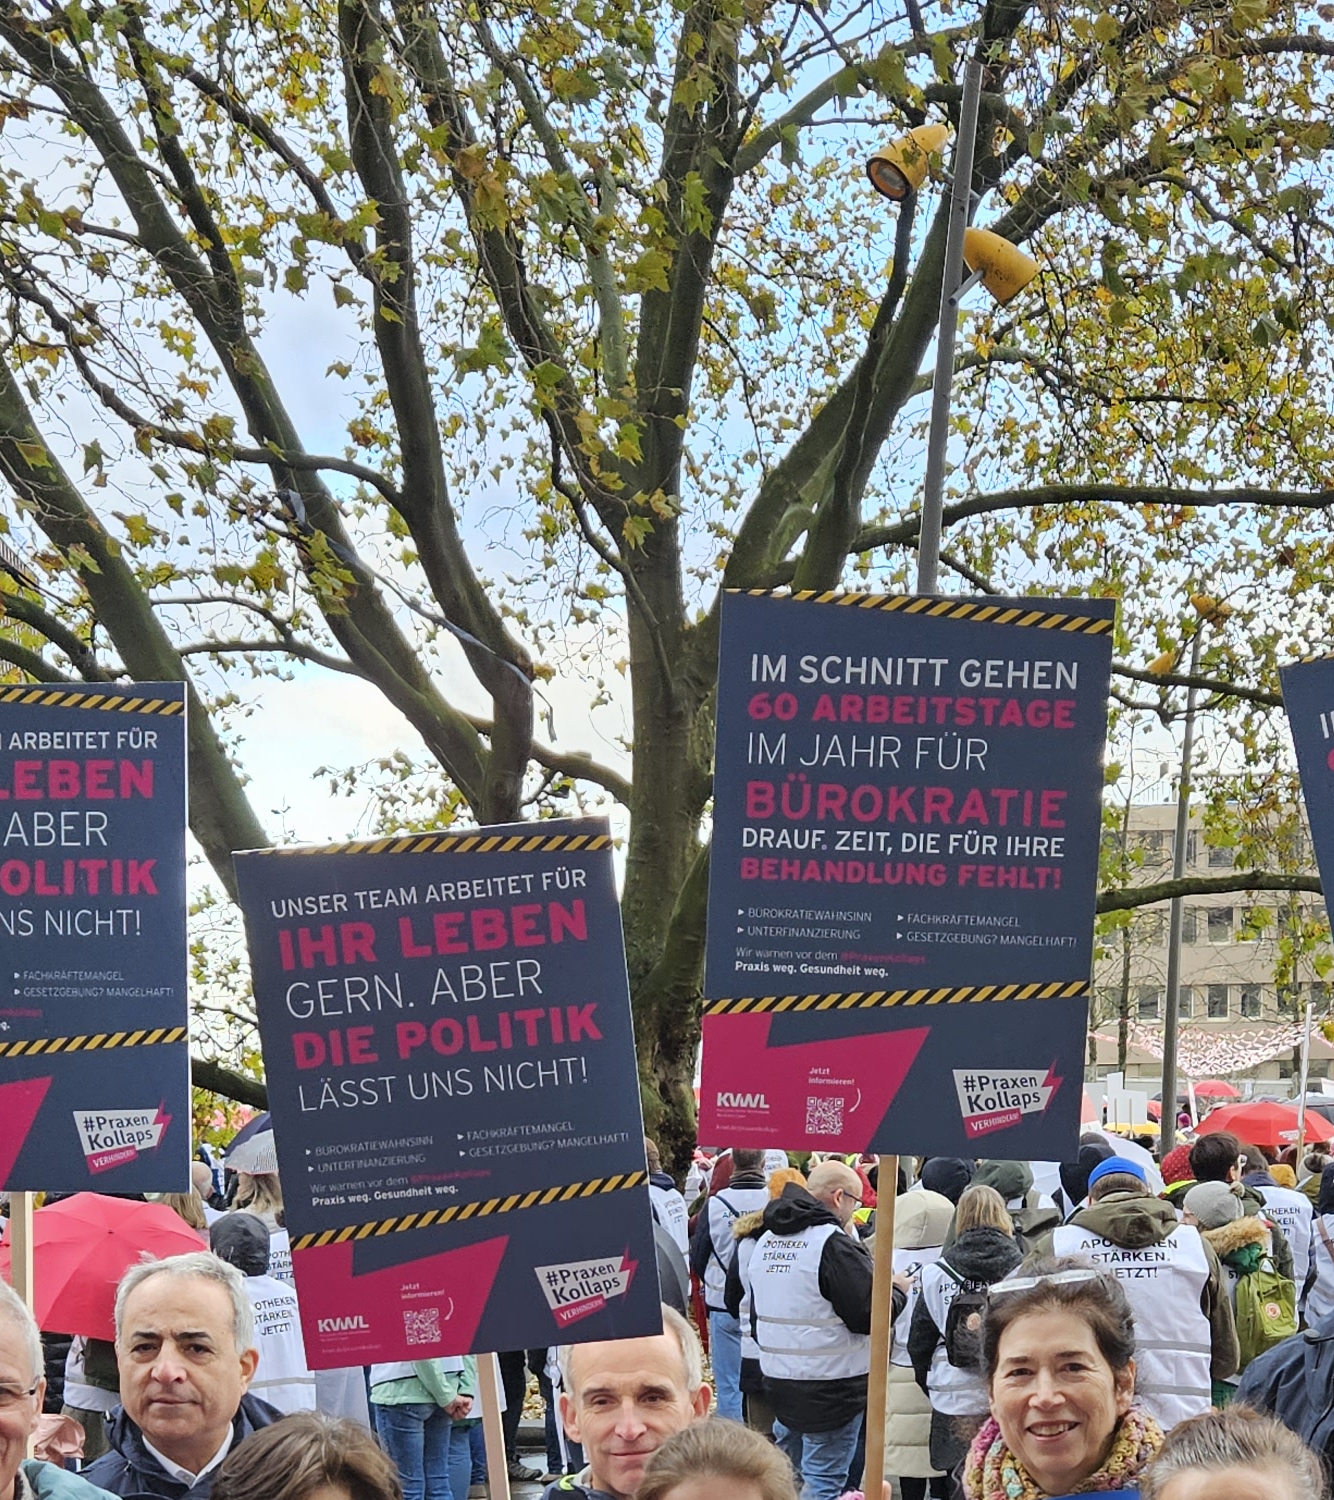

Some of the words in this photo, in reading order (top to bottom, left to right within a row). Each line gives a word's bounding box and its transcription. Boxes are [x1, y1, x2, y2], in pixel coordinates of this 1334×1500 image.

[751, 654, 787, 682] IM
[799, 655, 948, 687] SCHNITT
[960, 659, 1078, 689] GEHEN
[747, 692, 798, 721] 60
[811, 693, 1076, 729] ARBEITSTAGE
[9, 732, 110, 750] ARBEITET
[117, 728, 157, 749] FÜR
[748, 732, 786, 765] IM
[800, 734, 901, 769] JAHR
[915, 731, 988, 771] FÜR
[746, 773, 1068, 829] BÜROKRATIE
[3, 812, 108, 846] ABER
[742, 828, 828, 851] DRAUF.
[834, 831, 893, 855] ZEIT,
[901, 833, 941, 854] DIE
[948, 830, 997, 855] FÜR
[1006, 836, 1065, 857] IHRE
[740, 857, 947, 886] BEHANDLUNG
[958, 864, 1061, 889] FEHLT!
[272, 894, 347, 918] UNSER
[354, 886, 417, 910] TEAM
[425, 874, 533, 903] ARBEITET
[542, 866, 587, 888] FÜR
[45, 910, 141, 936] NICHT!
[279, 922, 377, 971] IHR
[398, 900, 588, 958] LEBEN
[747, 925, 860, 940] UNTERFINANZIERUNG
[906, 931, 997, 945] GESETZGEBUNG?
[999, 934, 1077, 948] MANGELHAFT!
[735, 961, 769, 974] Praxis
[773, 964, 797, 975] weg.
[800, 963, 861, 976] Gesundheit
[864, 967, 888, 978] weg.
[286, 973, 414, 1019] GERN.
[431, 960, 543, 1005] ABER
[292, 1026, 378, 1070] DIE
[395, 1003, 602, 1060] POLITIK
[299, 1075, 396, 1112] LÄSST
[408, 1068, 473, 1100] UNS
[483, 1057, 588, 1092] NICHT!
[963, 1074, 1037, 1092] #Praxen
[717, 1093, 769, 1109] KVWL
[967, 1089, 1041, 1112] Kollaps
[83, 1114, 149, 1131] #Praxen
[87, 1128, 153, 1151] Kollaps
[763, 1241, 808, 1249] APOTHEKEN
[1092, 1249, 1170, 1264] STÄRKEN.
[546, 1262, 615, 1286] #Praxen
[766, 1265, 790, 1273] JETZT!
[551, 1275, 621, 1304] Kollaps
[318, 1315, 369, 1333] KVWL
